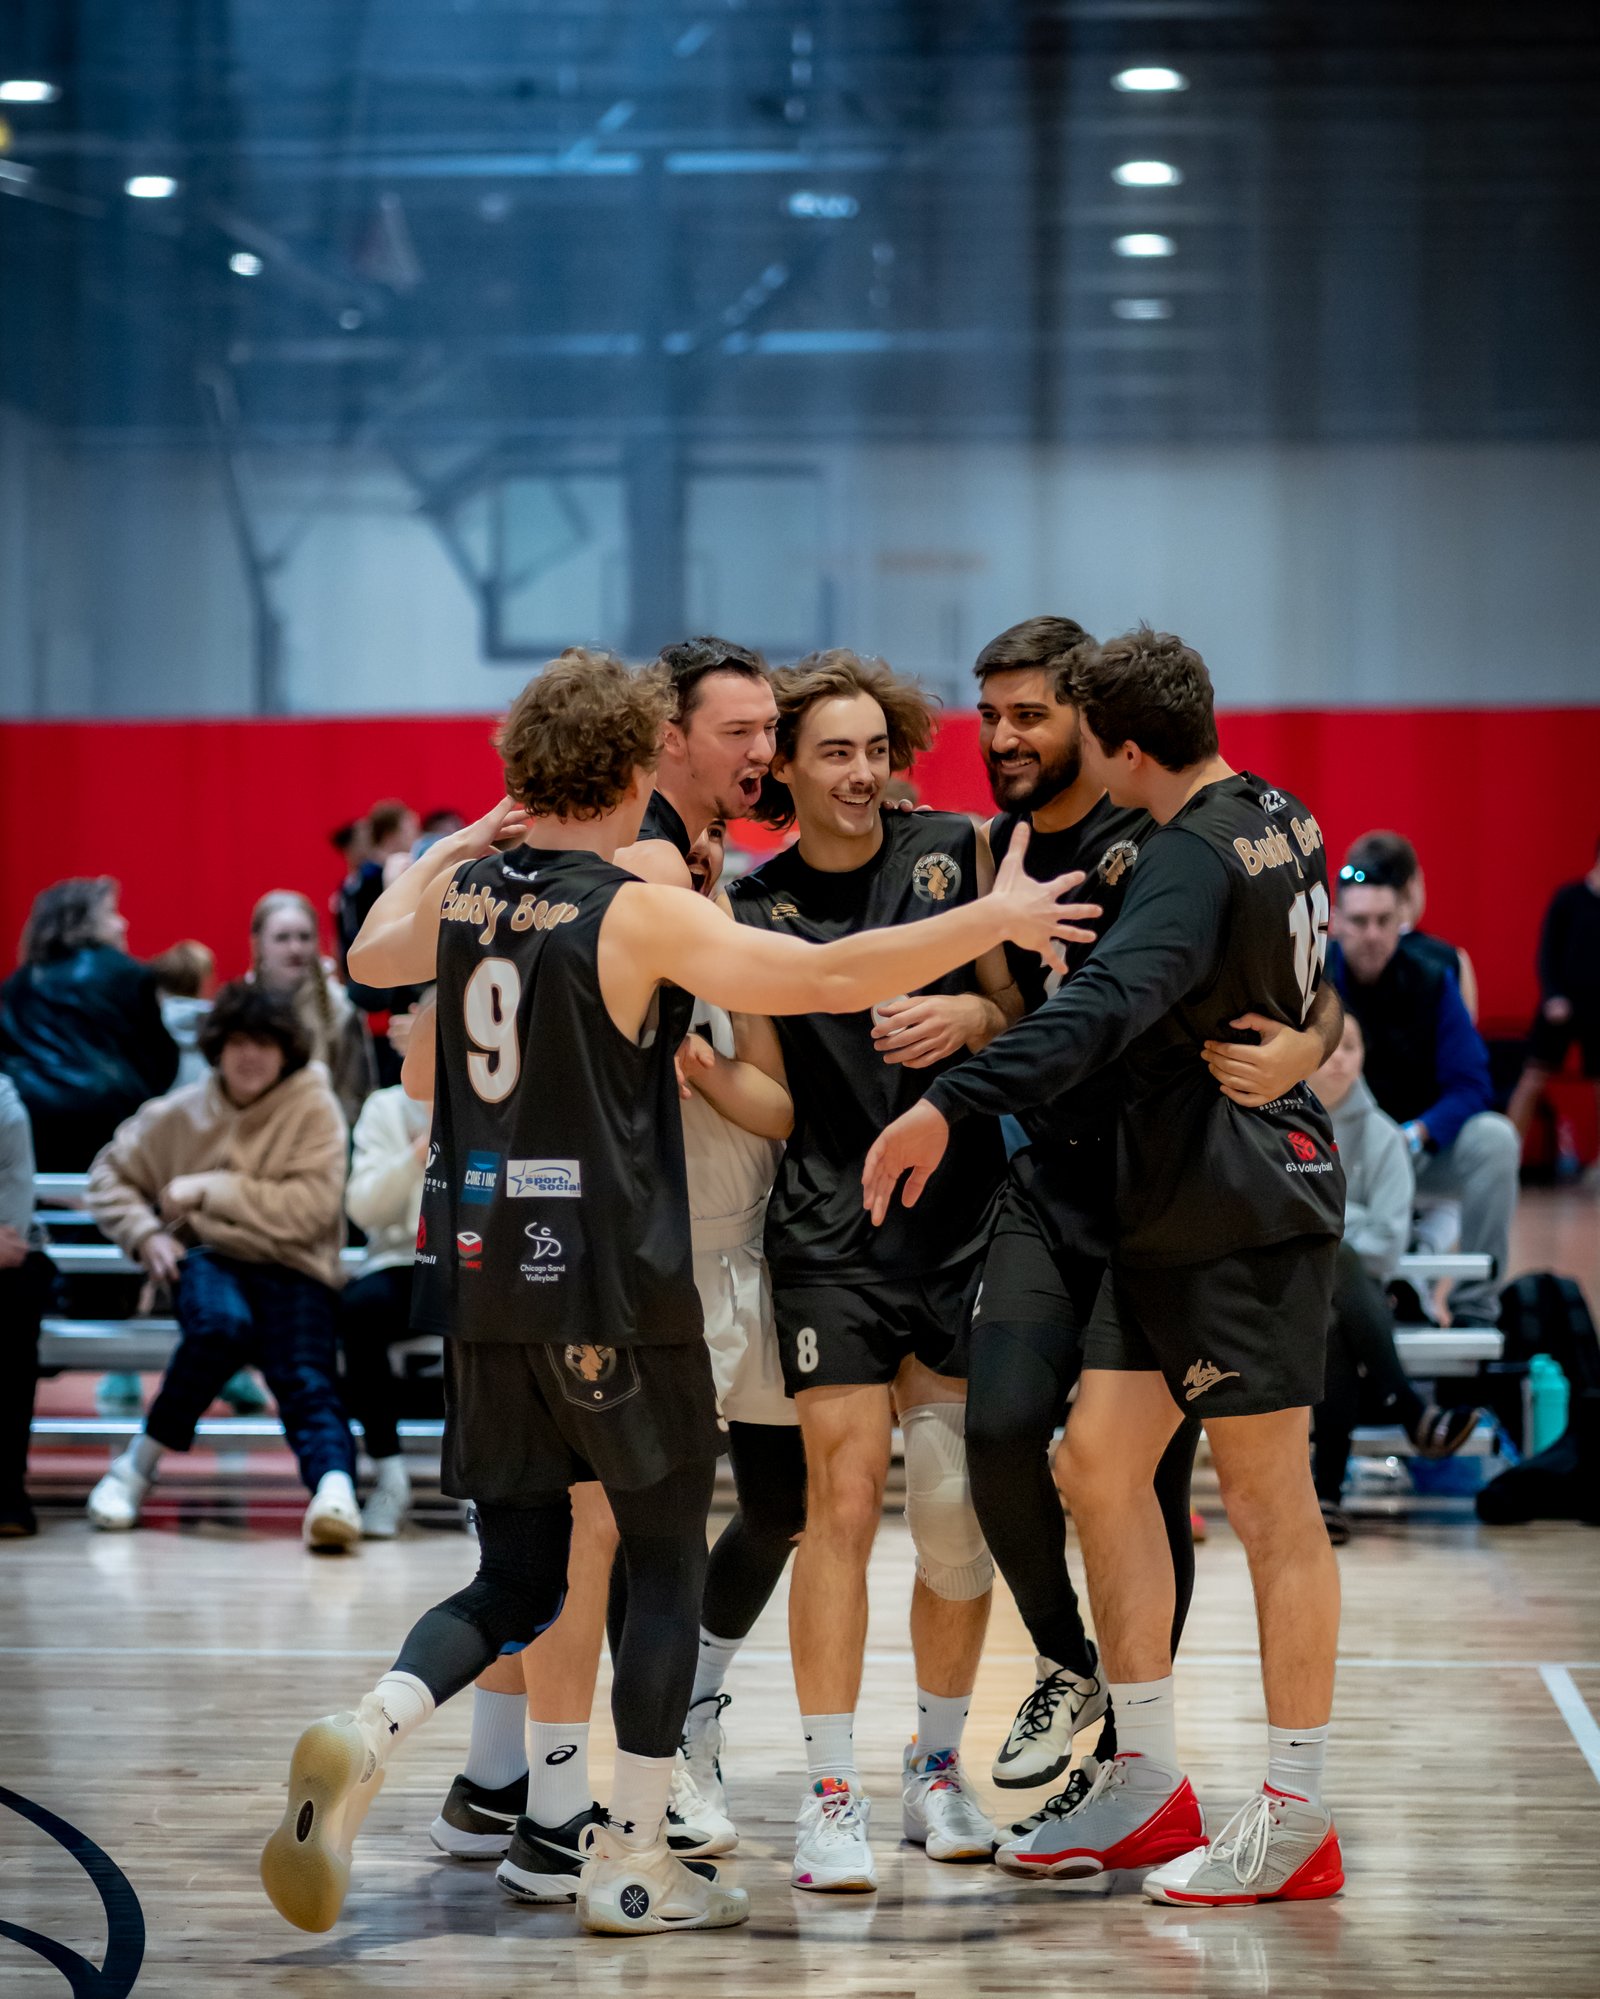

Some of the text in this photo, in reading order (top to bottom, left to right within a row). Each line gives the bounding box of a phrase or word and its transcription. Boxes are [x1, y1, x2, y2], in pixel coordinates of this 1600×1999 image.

[919, 855, 937, 868] Buddy
[441, 881, 508, 945] Buddy
[464, 956, 522, 1103] 9
[1286, 1162, 1333, 1174] 63 Volleyball
[424, 1177, 447, 1189] ORLD
[525, 1175, 564, 1186] sport
[538, 1180, 581, 1191] social
[519, 1264, 566, 1274] Chicago Sand
[525, 1273, 559, 1284] Volleyball
[797, 1327, 819, 1372] 8
